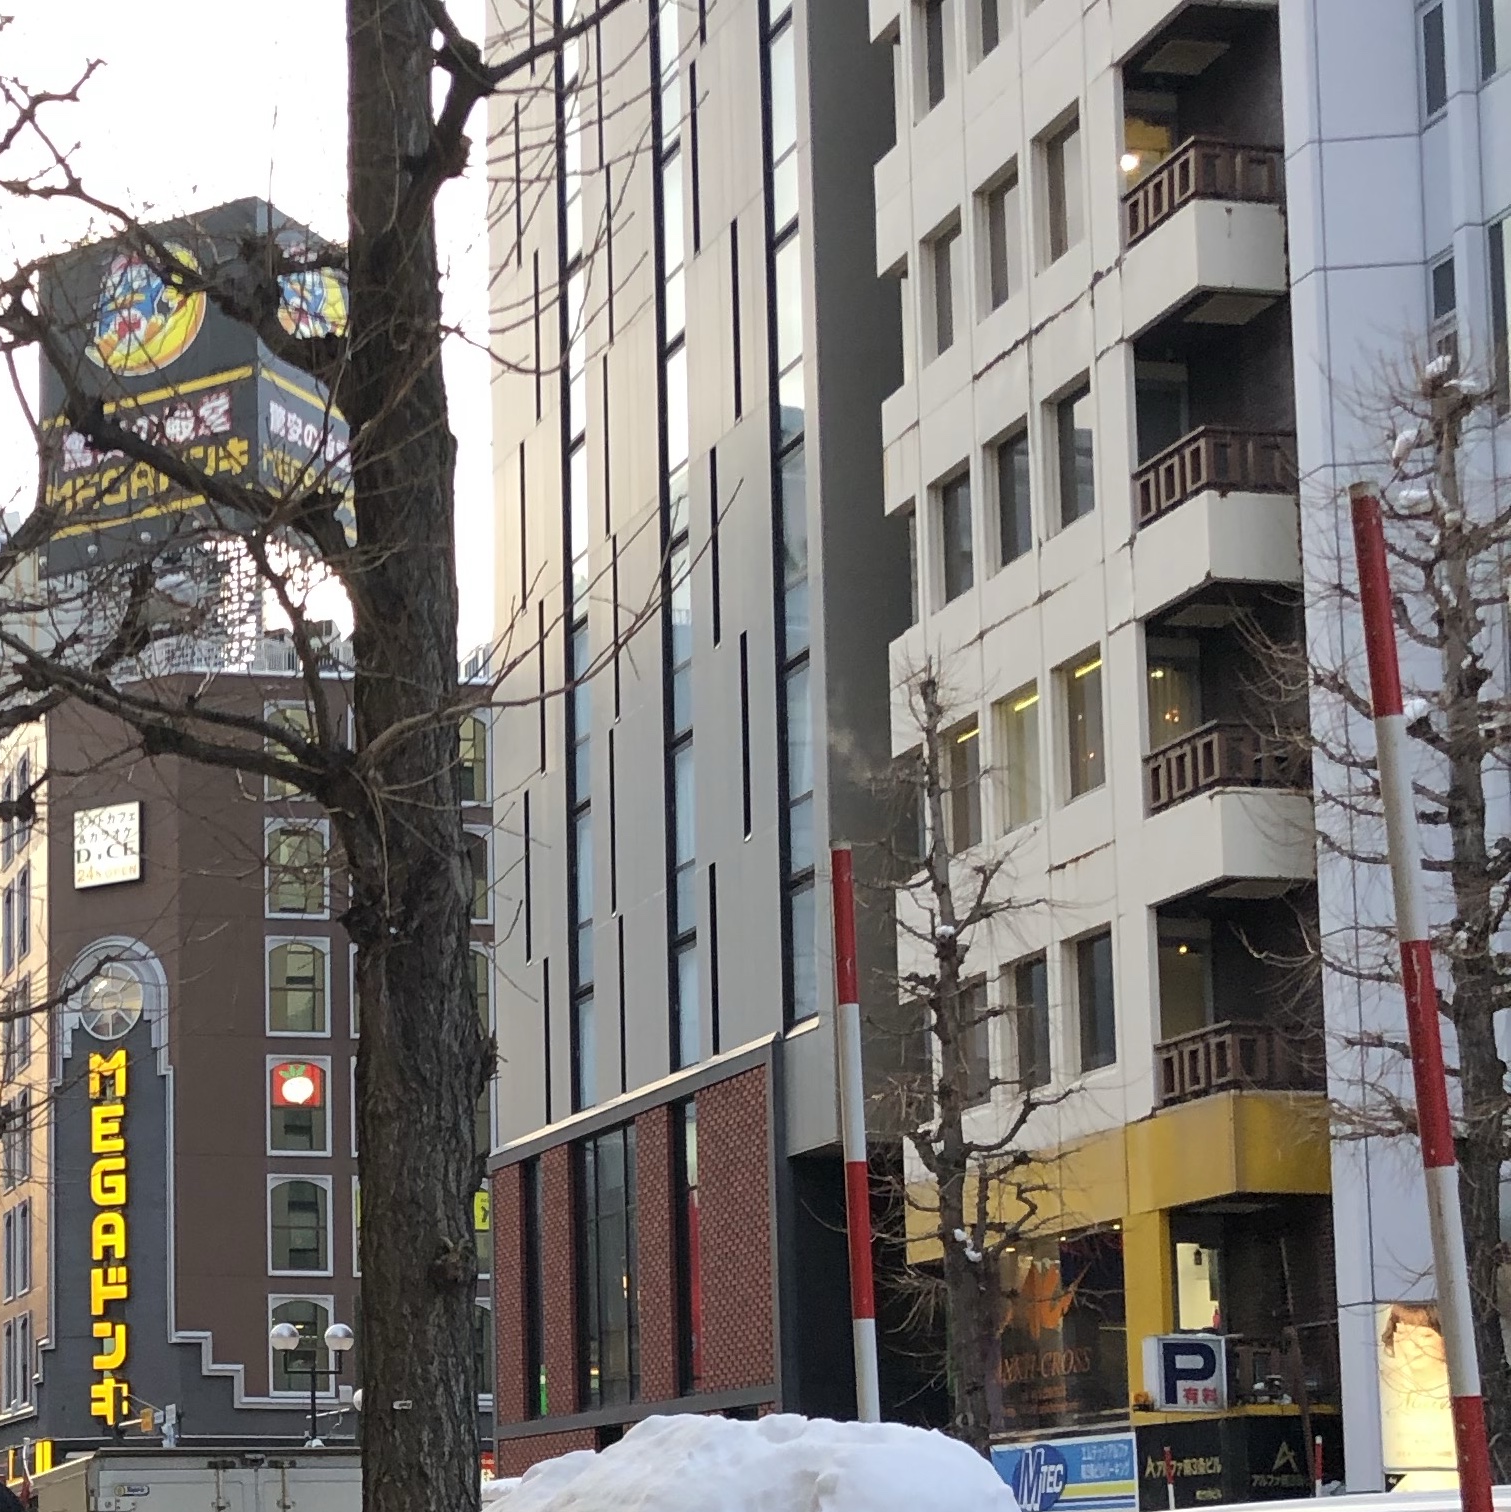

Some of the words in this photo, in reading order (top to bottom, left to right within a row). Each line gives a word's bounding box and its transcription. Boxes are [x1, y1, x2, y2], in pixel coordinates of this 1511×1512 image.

[88, 1047, 129, 1427] MEGAドンキ
[1162, 1343, 1216, 1404] P
